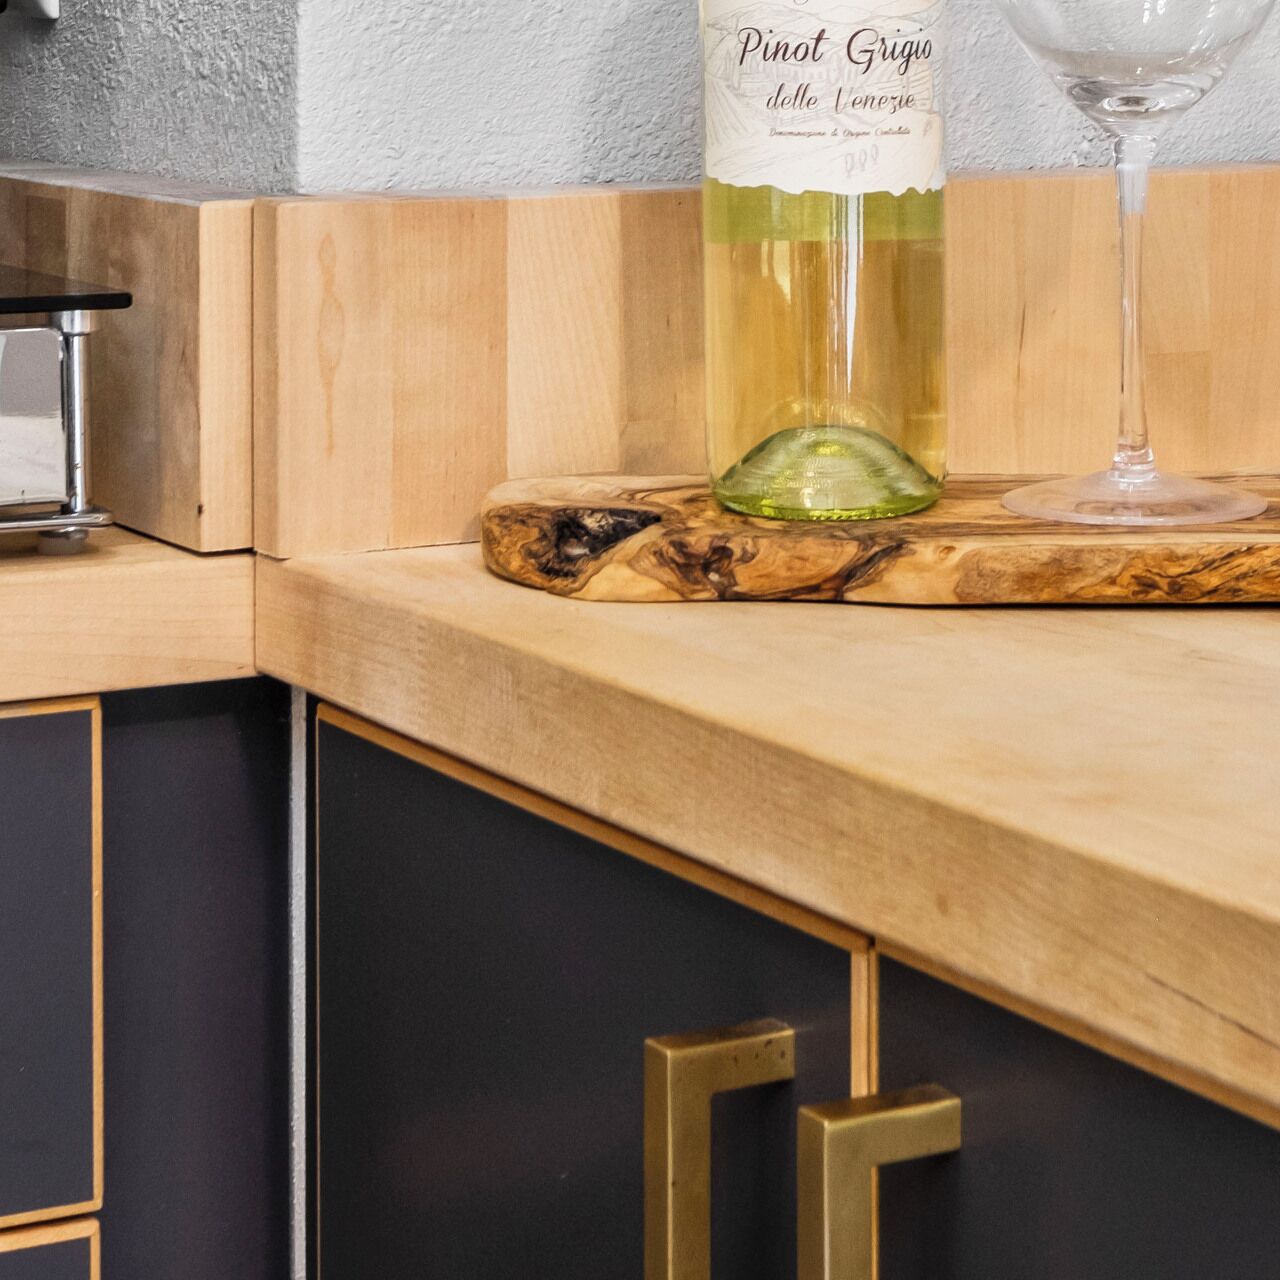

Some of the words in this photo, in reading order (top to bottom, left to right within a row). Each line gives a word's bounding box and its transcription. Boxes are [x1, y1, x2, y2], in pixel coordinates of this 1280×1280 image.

[737, 27, 830, 66] Pinot
[846, 27, 933, 76] Grigio
[766, 82, 818, 111] delle
[835, 84, 915, 115] Venezie
